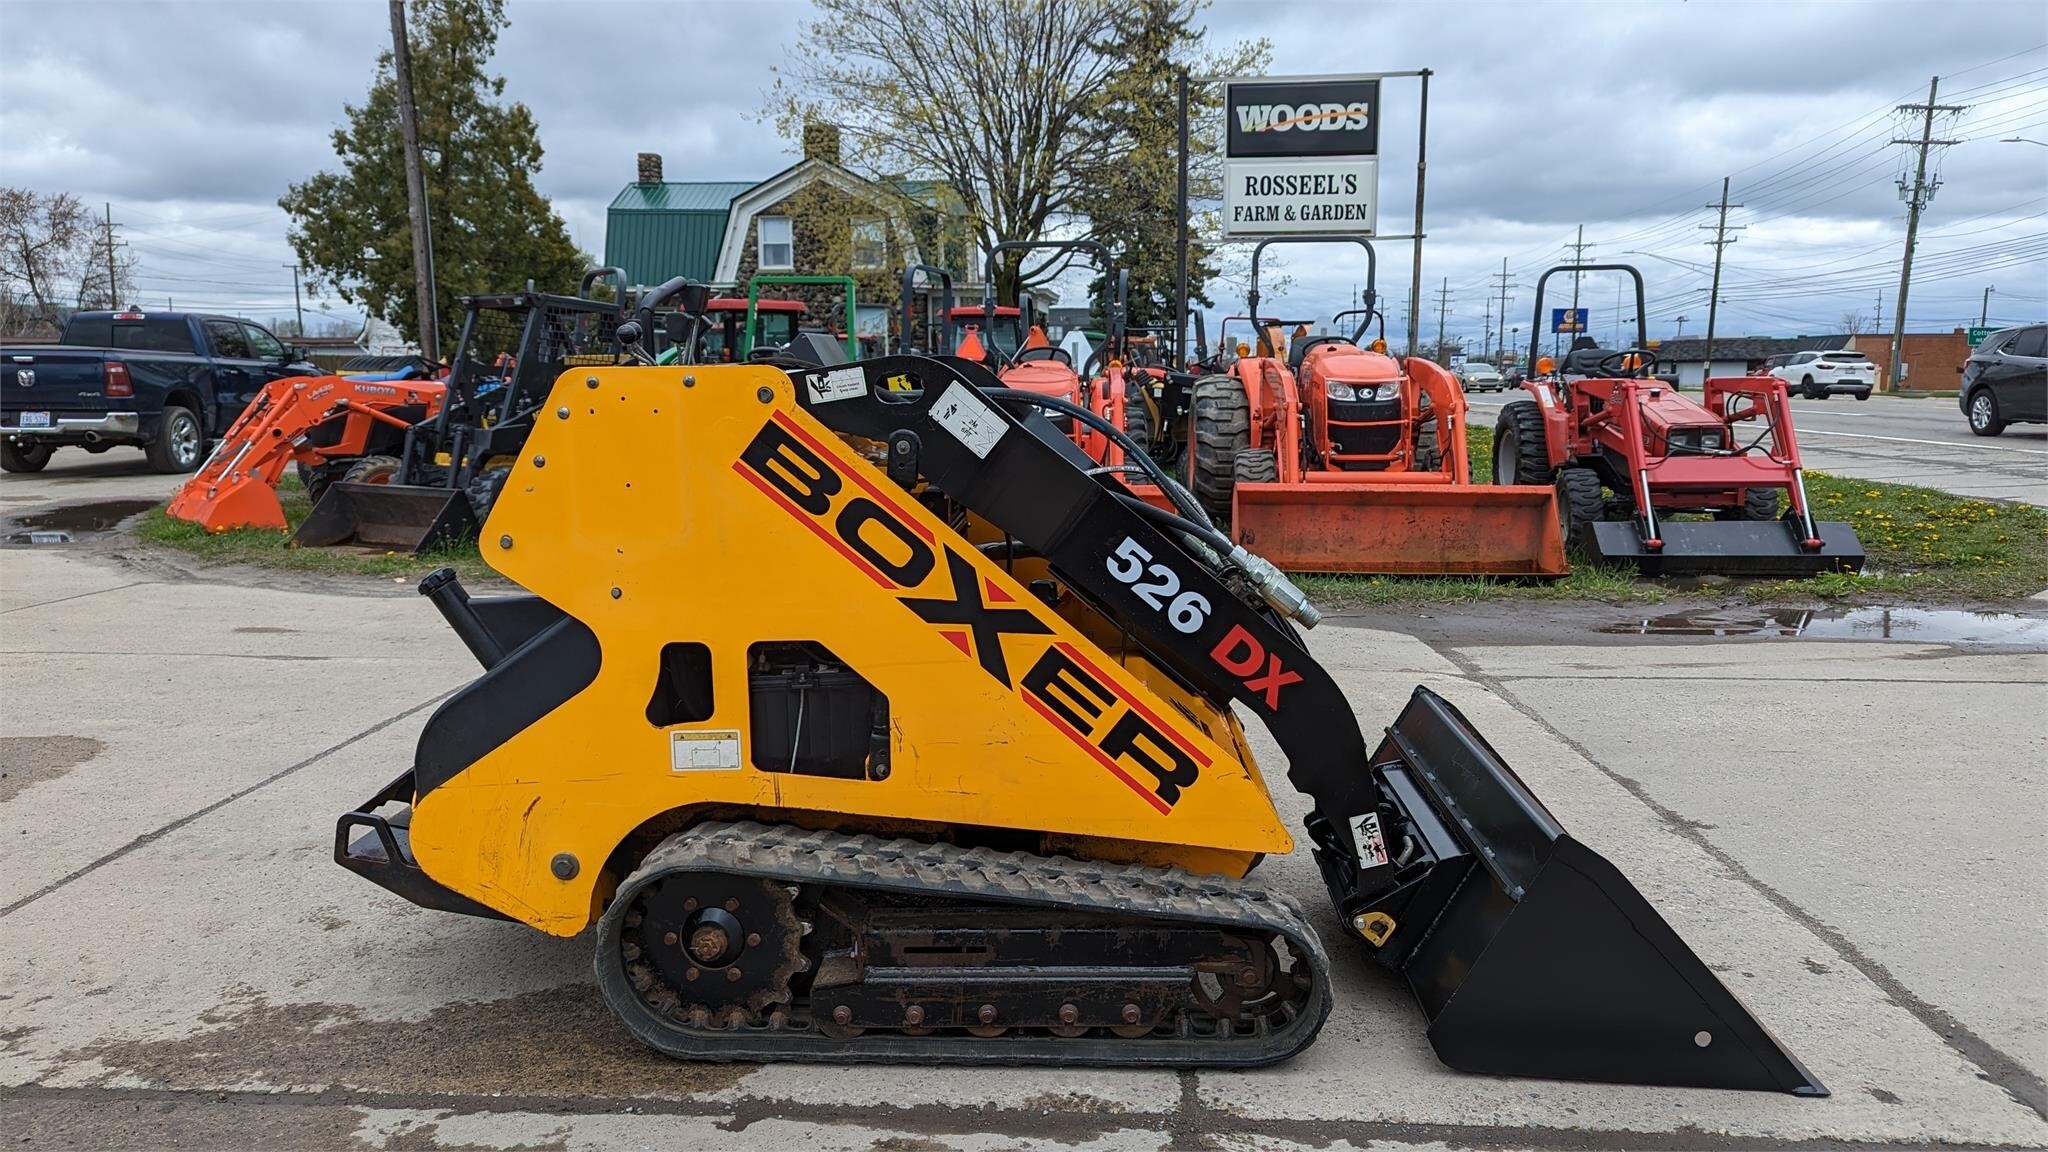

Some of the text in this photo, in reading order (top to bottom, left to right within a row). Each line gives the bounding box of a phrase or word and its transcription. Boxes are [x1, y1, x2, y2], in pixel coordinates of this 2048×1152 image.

[1236, 102, 1369, 132] WOODS
[1244, 173, 1358, 197] ROSSEEL'S
[1233, 203, 1368, 222] FARM & GARDEN
[354, 383, 397, 395] KUBOTA
[740, 419, 1199, 807] BOXER
[1106, 536, 1304, 711] 526 DX
